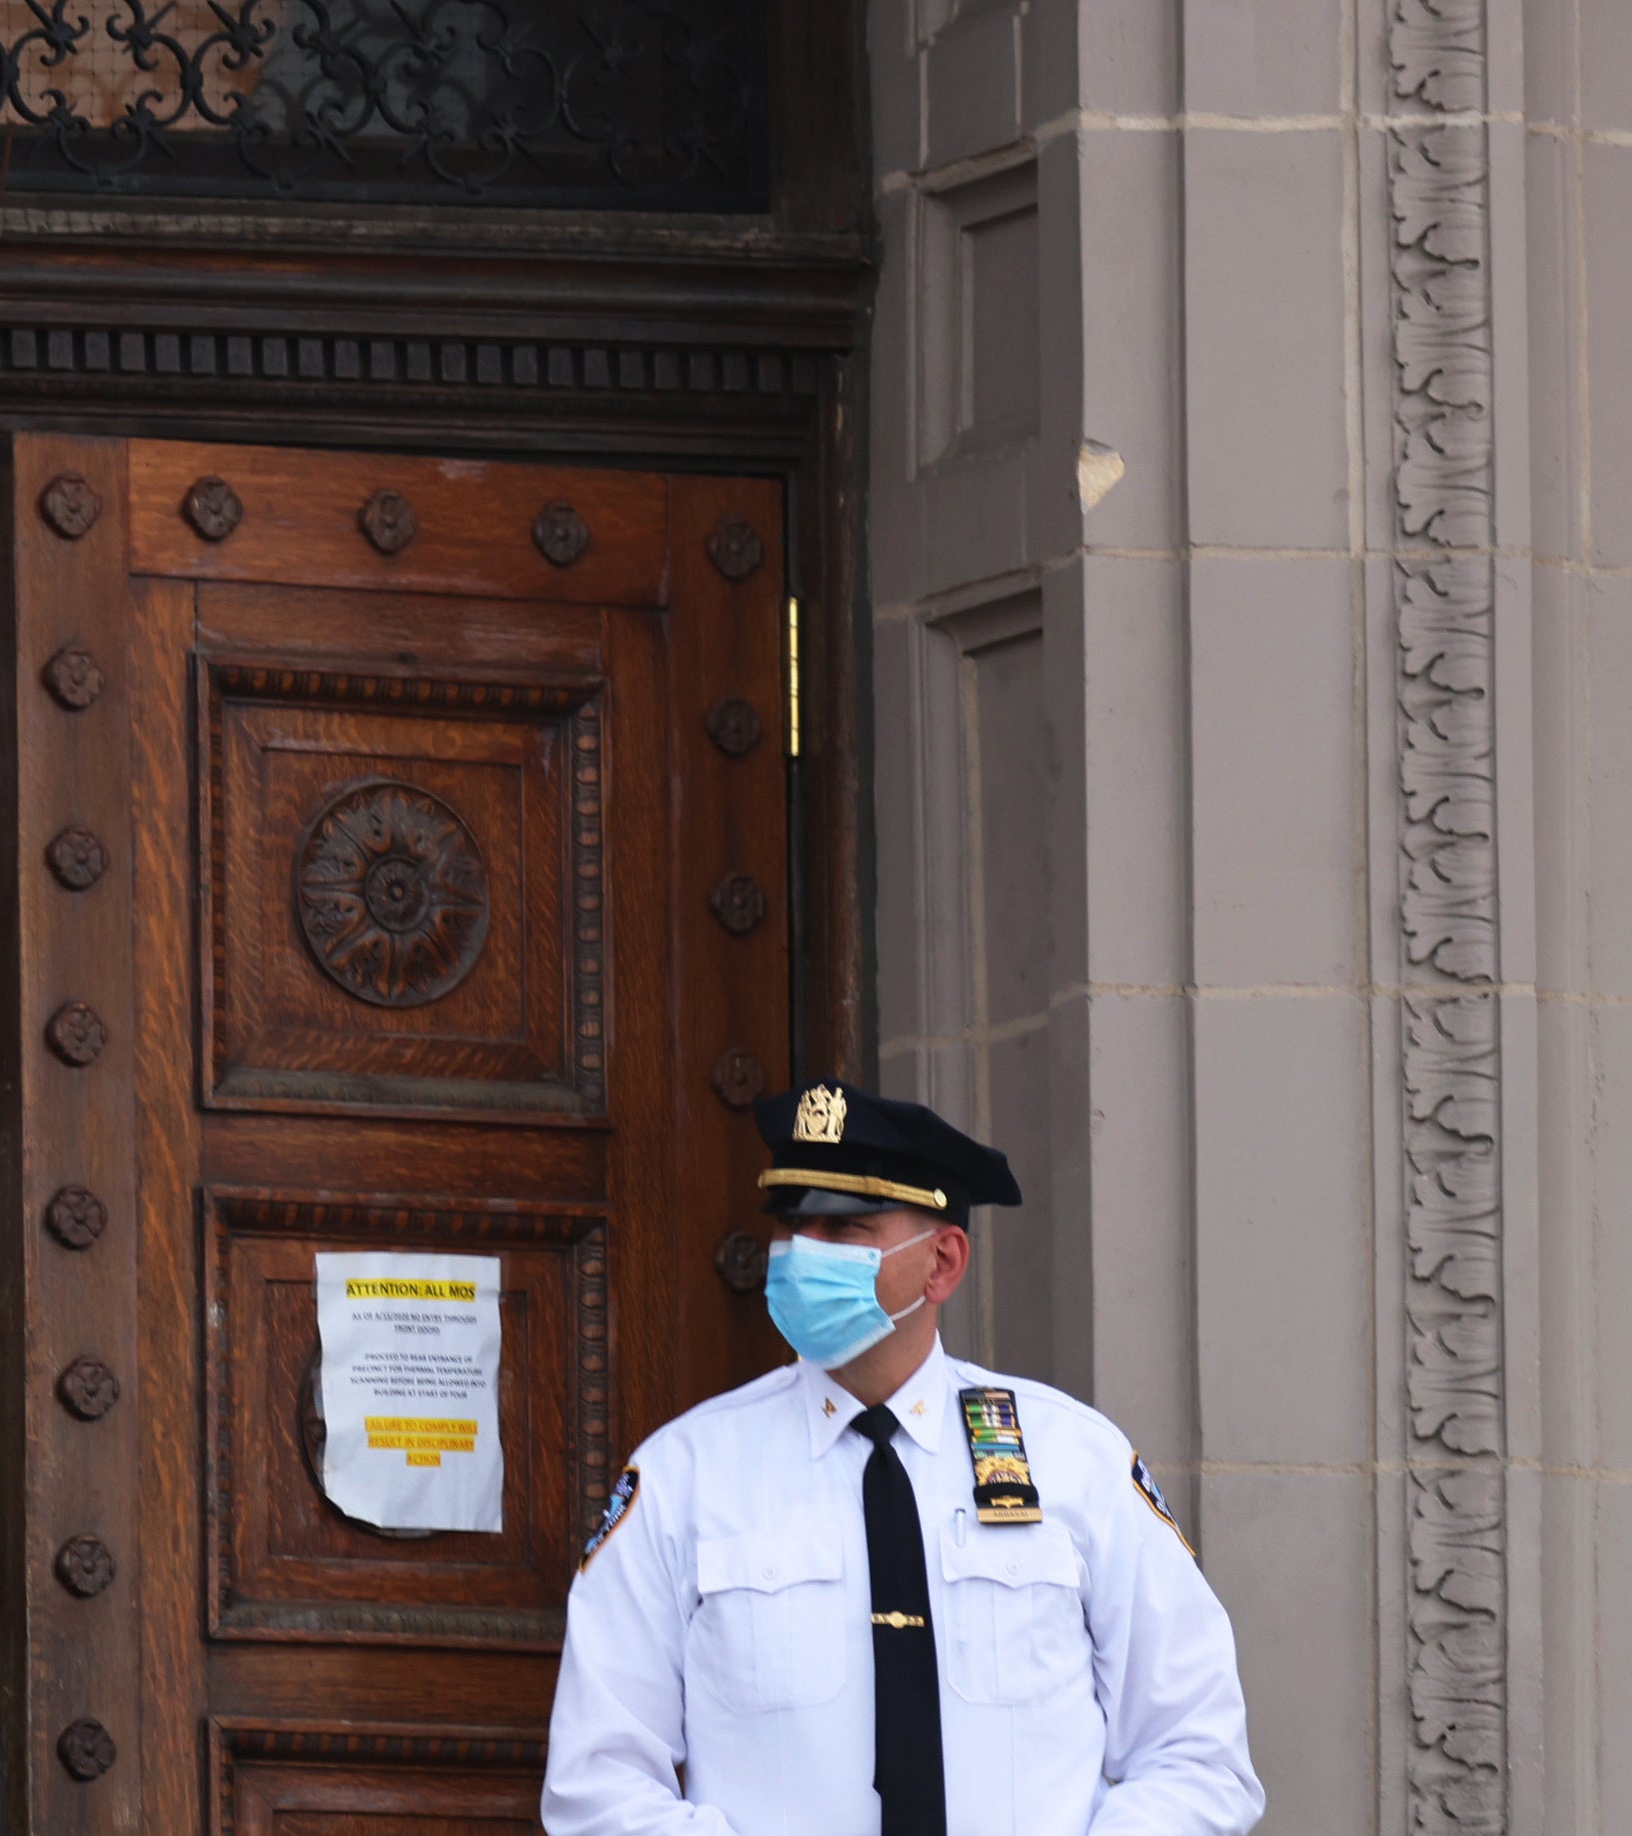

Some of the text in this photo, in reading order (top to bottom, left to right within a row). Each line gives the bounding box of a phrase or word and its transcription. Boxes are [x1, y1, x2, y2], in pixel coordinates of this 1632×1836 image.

[347, 1282, 476, 1300] ATTENTION: ALL MOS
[365, 1352, 399, 1361] PROCEED
[427, 1353, 463, 1363] ENTRANCE
[352, 1364, 483, 1376] PRECINCT FOR THERMAL TEMPERATURE
[349, 1376, 389, 1385] SCANNING
[390, 1377, 415, 1386] BEFORE
[416, 1378, 437, 1387] BEING
[437, 1378, 469, 1388] ALLOWED
[374, 1388, 406, 1398] BUILDING
[417, 1389, 438, 1399] START
